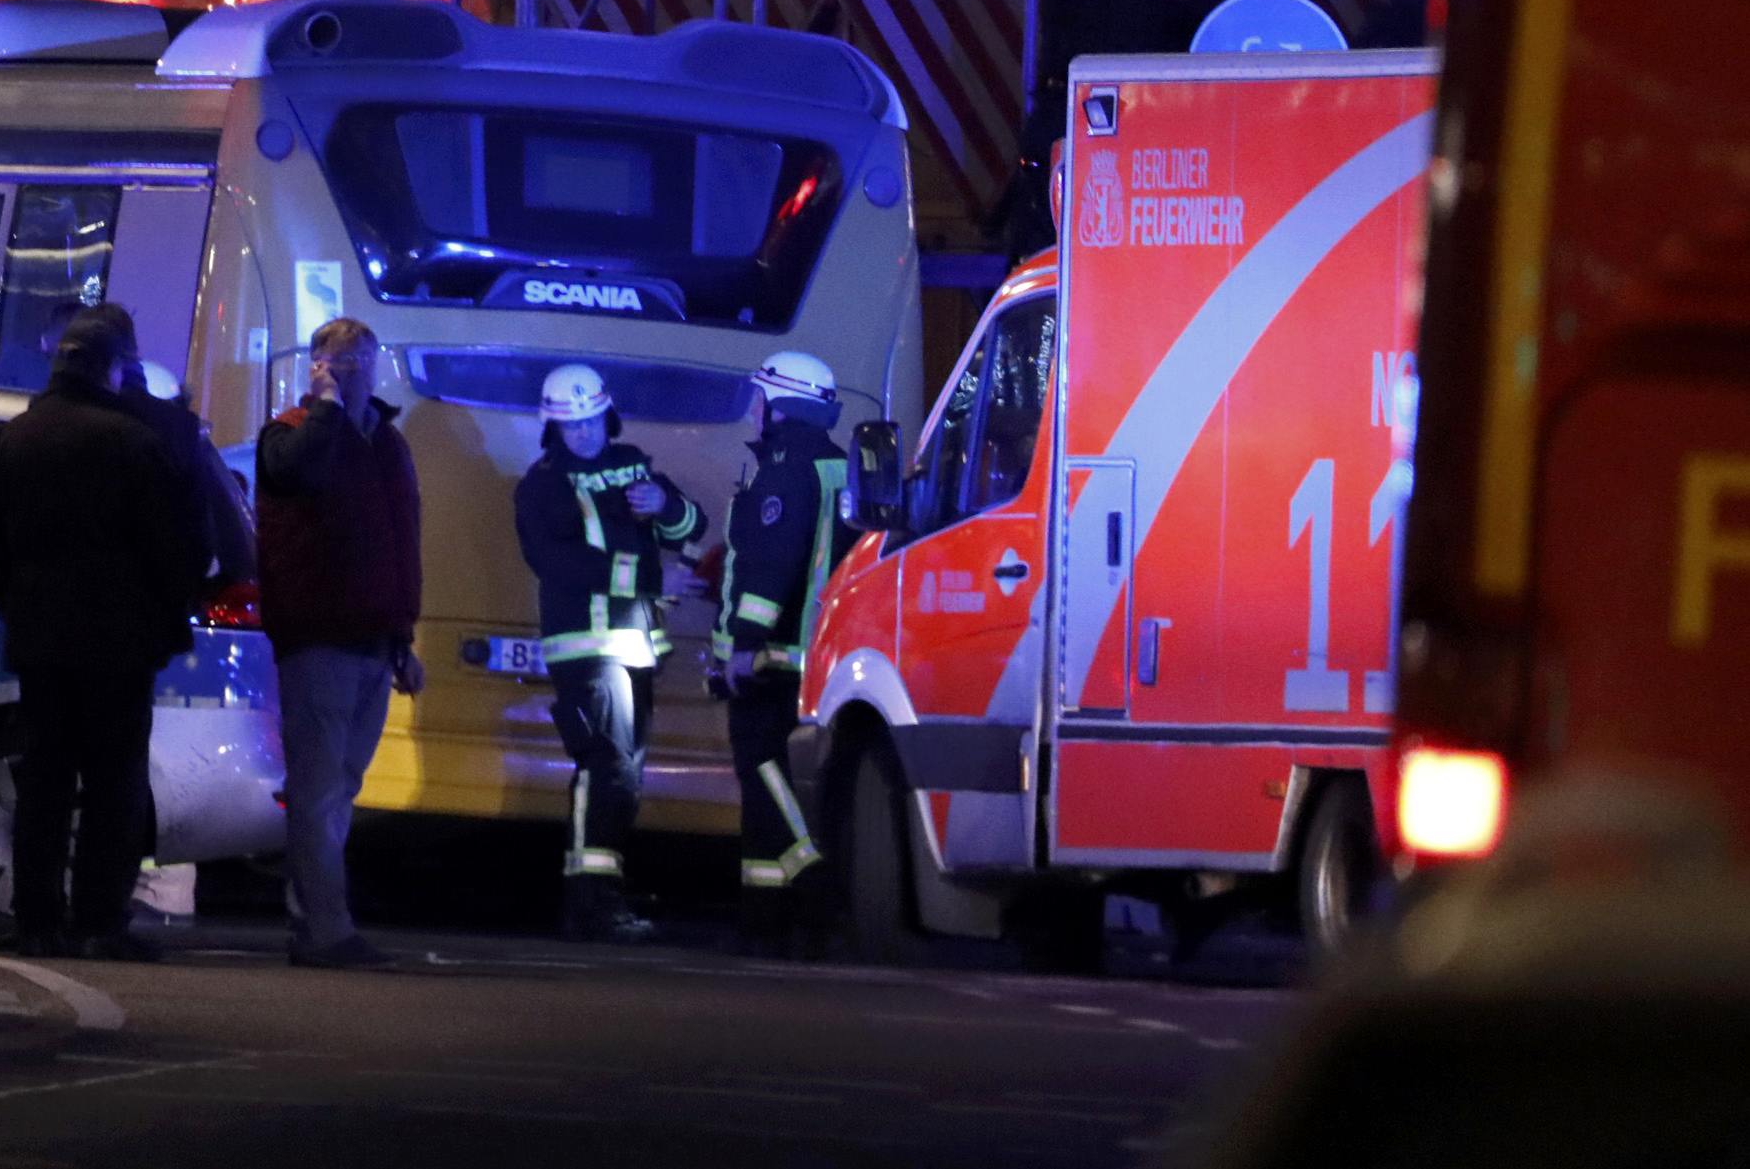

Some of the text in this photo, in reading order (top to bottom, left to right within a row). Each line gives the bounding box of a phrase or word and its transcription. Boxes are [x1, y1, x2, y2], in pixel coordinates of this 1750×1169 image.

[1132, 147, 1209, 190] BERLINER
[1130, 195, 1245, 246] FEUERWEHR
[523, 279, 643, 311] SCANIA
